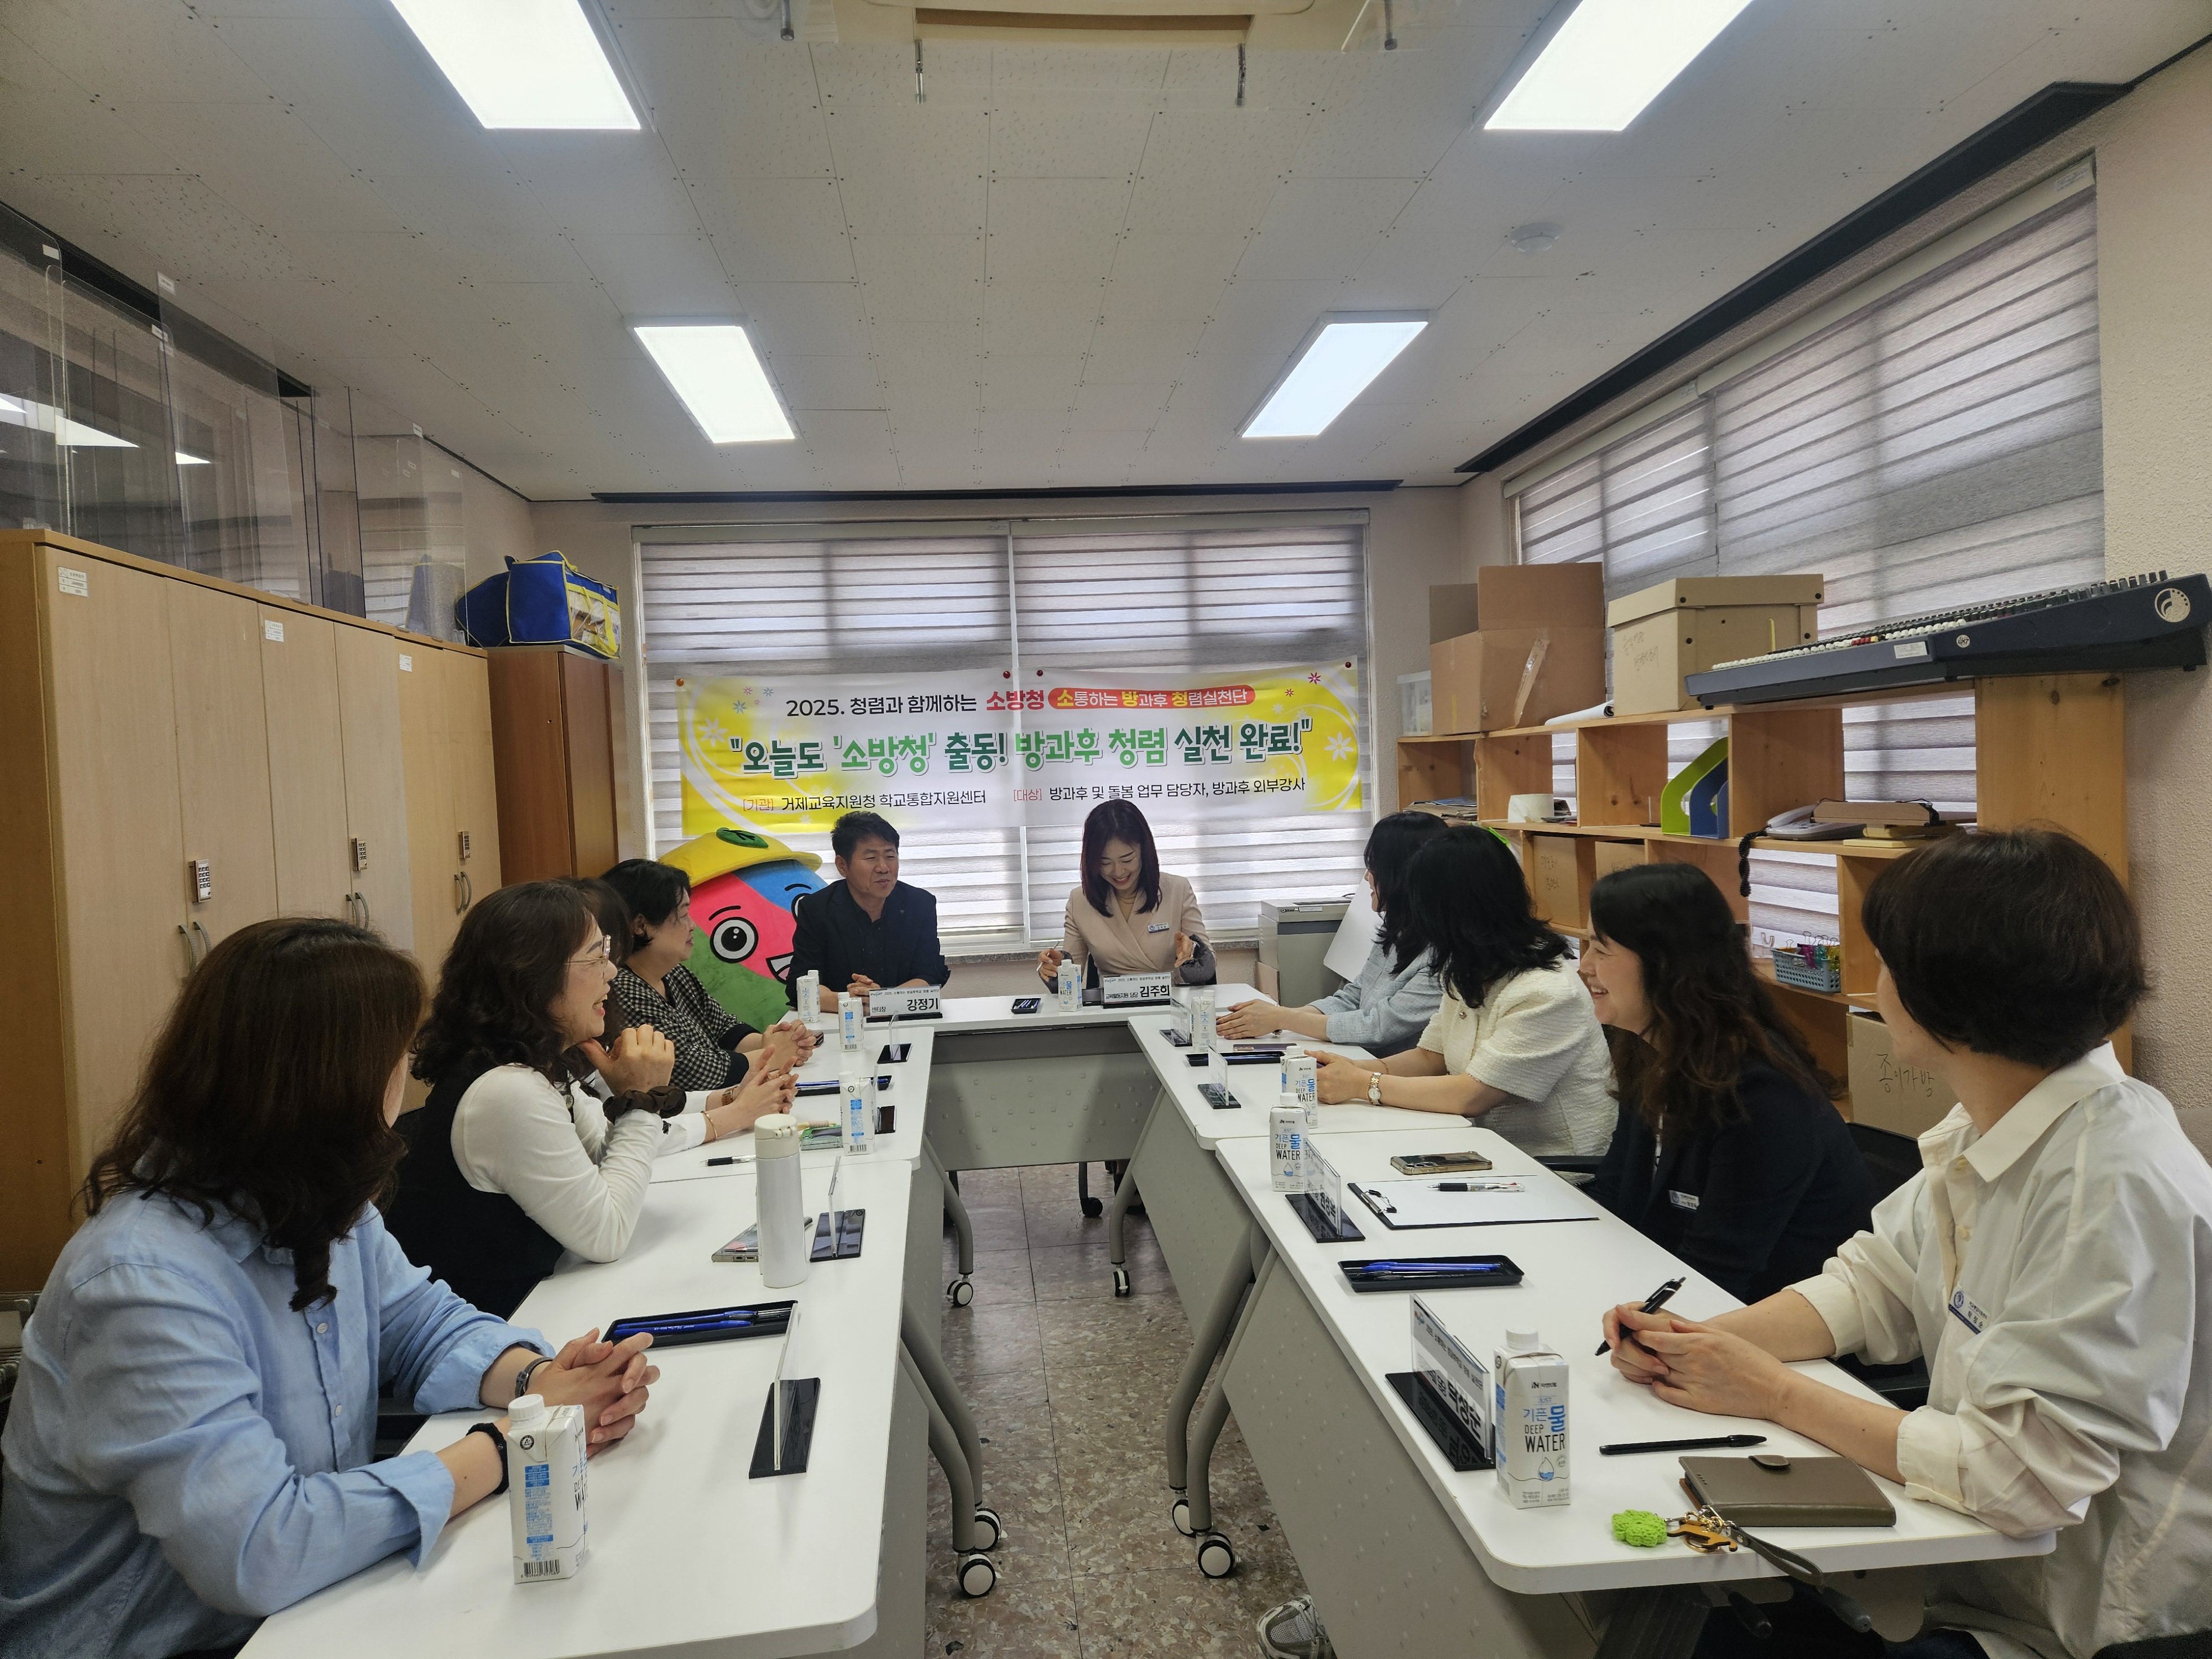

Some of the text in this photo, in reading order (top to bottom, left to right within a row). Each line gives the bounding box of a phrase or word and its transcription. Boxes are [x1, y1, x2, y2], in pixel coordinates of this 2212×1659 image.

[786, 688, 1248, 717] 2025. 청렴과 함께하는 소방청 소통하는 방과후 청렴실천단
[730, 718, 1312, 778] "오늘도 '소방청' 출동! 방과후 청렴 실천 완료!"
[1013, 778, 1306, 802] [대상] 방과후 및 돌봄 업무 담당자, 방과후 외부강사
[743, 791, 987, 811] [기관] 거제교육지원청 학교통합지원센터
[1140, 985, 1170, 998] 김주희
[907, 998, 938, 1011] 강정기
[1876, 1053, 1934, 1097] 종이가방
[1276, 1150, 1301, 1160] WATER
[1525, 1424, 1544, 1434] DEEP
[1525, 1433, 1565, 1453] WATER
